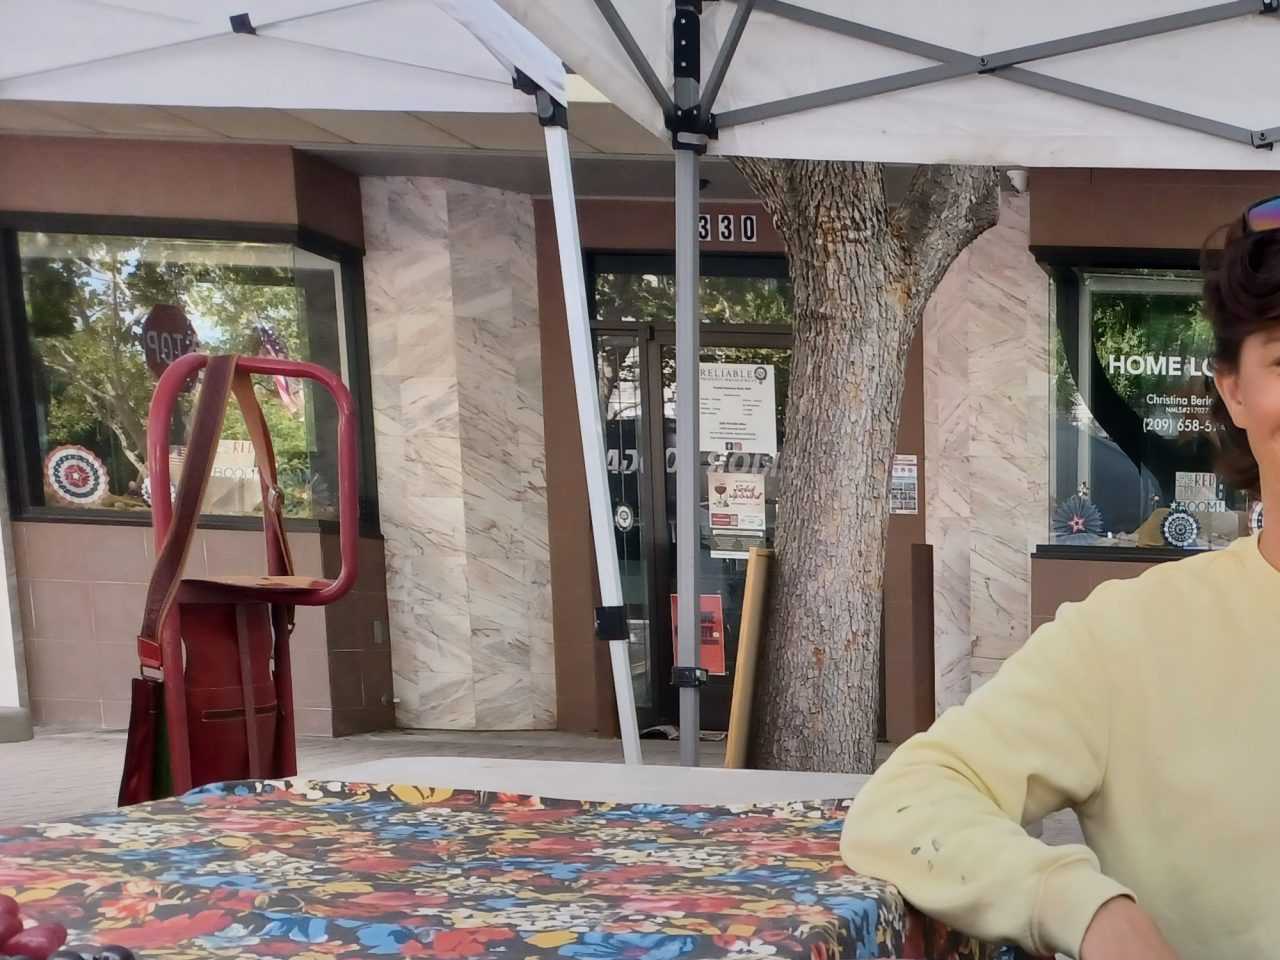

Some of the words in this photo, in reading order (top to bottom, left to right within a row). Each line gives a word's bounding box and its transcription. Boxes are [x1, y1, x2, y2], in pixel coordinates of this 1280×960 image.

[699, 215, 755, 240] 330
[1109, 355, 1182, 376] HOME
[1190, 356, 1215, 377] LO
[700, 368, 753, 379] RELIABLE
[1146, 394, 1188, 405] Christina
[1143, 418, 1173, 432] (209)
